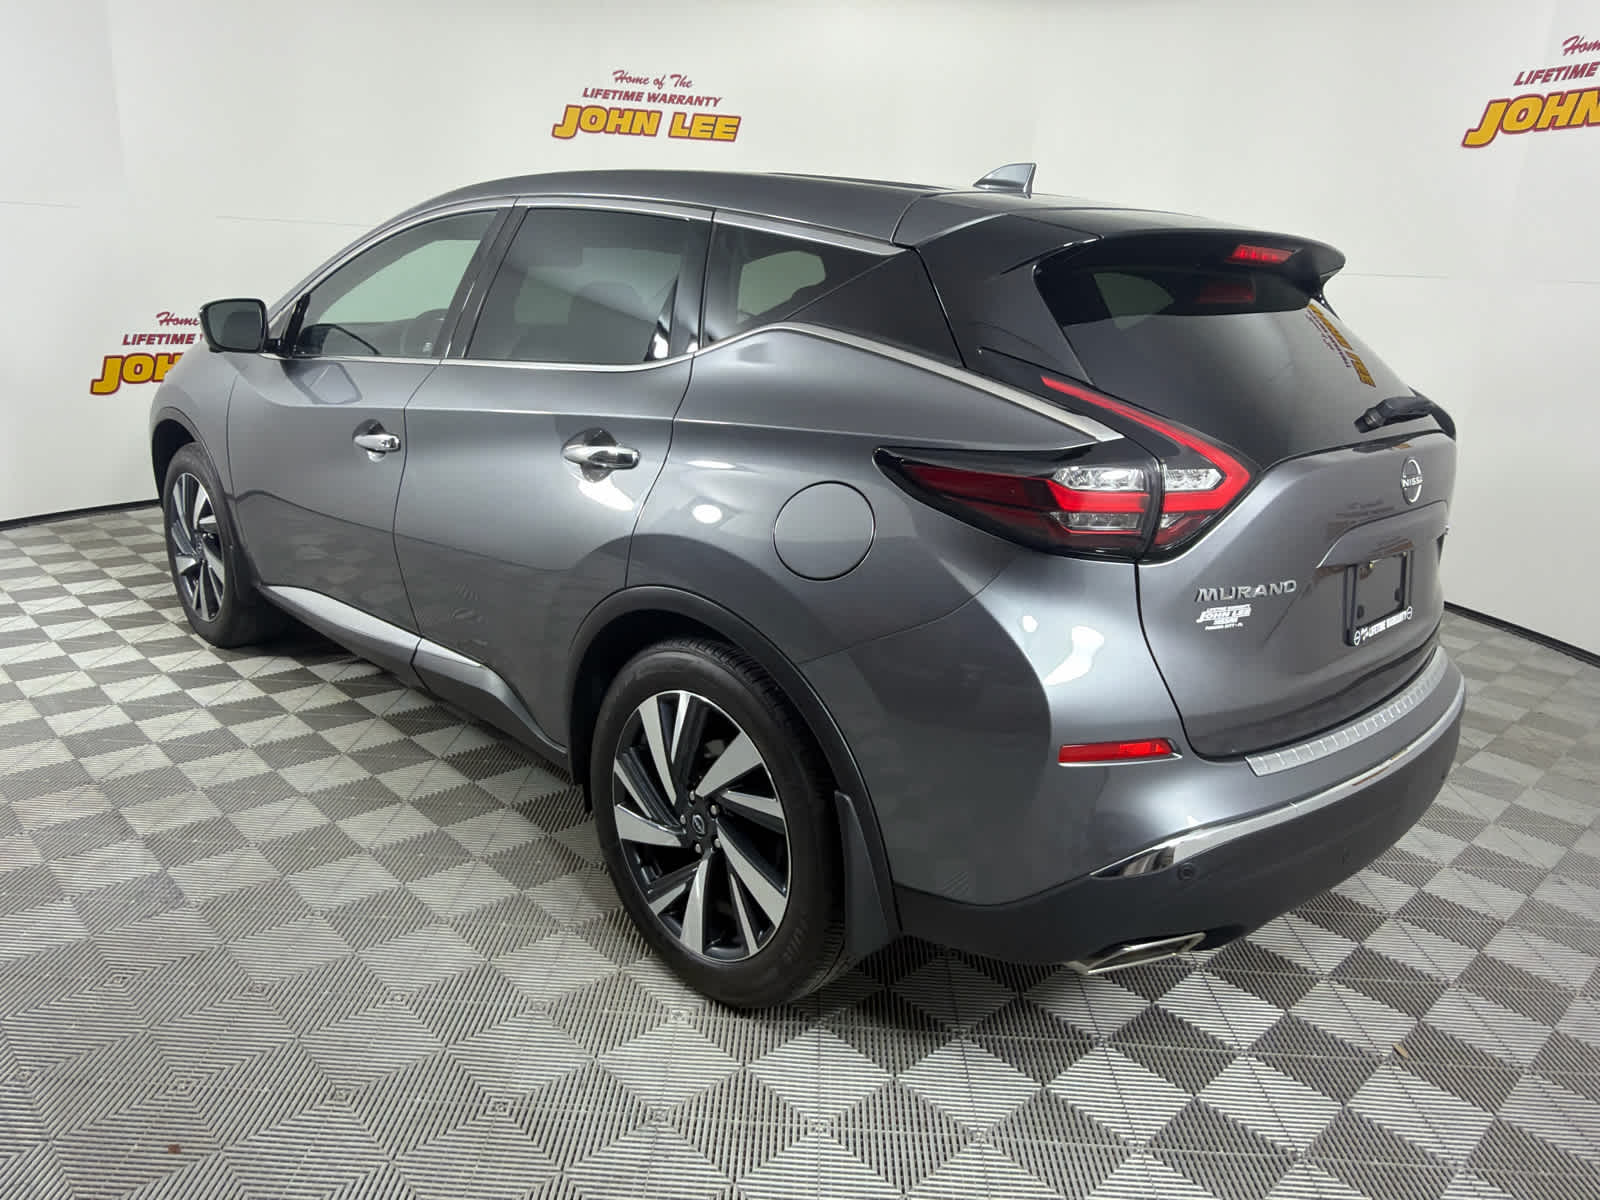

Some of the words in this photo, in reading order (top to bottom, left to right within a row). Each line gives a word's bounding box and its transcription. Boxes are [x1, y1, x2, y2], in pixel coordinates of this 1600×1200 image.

[1562, 35, 1600, 56] Hom
[612, 69, 649, 86] Home
[653, 74, 667, 90] of
[670, 73, 693, 89] The
[1513, 61, 1600, 86] LIFETIME
[582, 87, 645, 102] LIFETIME
[647, 92, 722, 107] WARRANTY
[551, 104, 663, 140] JOHN
[668, 111, 741, 142] LEE
[1461, 86, 1600, 148] JOHN
[156, 311, 200, 326] Home
[122, 333, 196, 345] LIFETIME
[90, 352, 184, 396] JOH
[1194, 579, 1297, 602] MURANO
